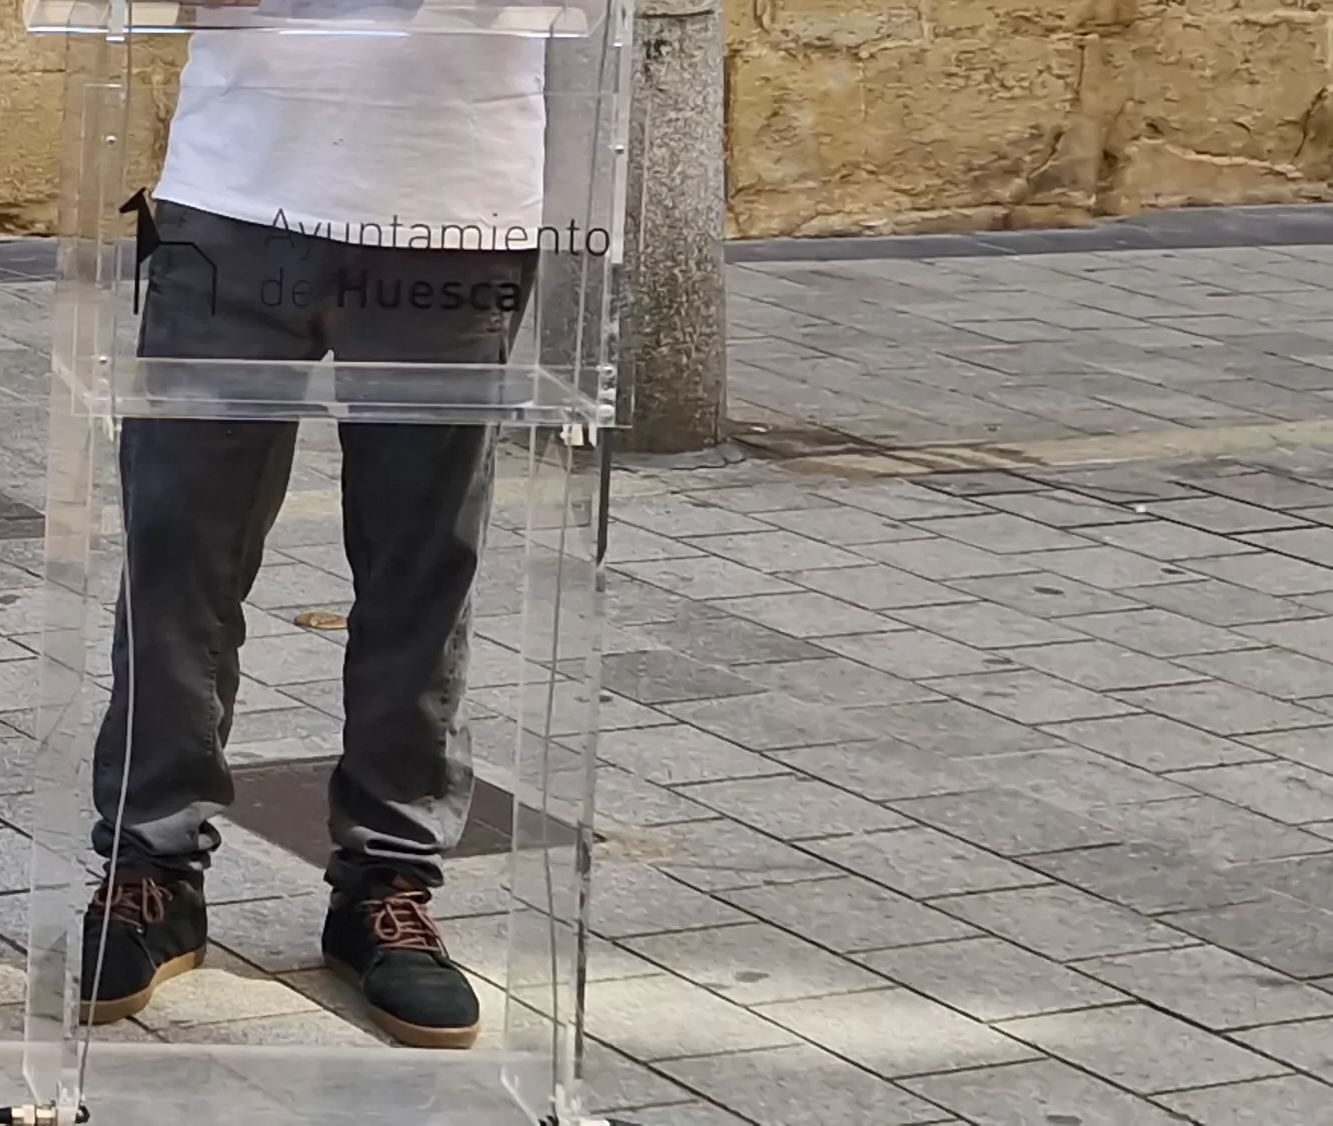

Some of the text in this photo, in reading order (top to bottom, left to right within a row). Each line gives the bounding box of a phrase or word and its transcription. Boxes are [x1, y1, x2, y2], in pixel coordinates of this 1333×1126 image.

[264, 208, 611, 261] Ayuntamiento
[259, 268, 522, 313] de Huesca
